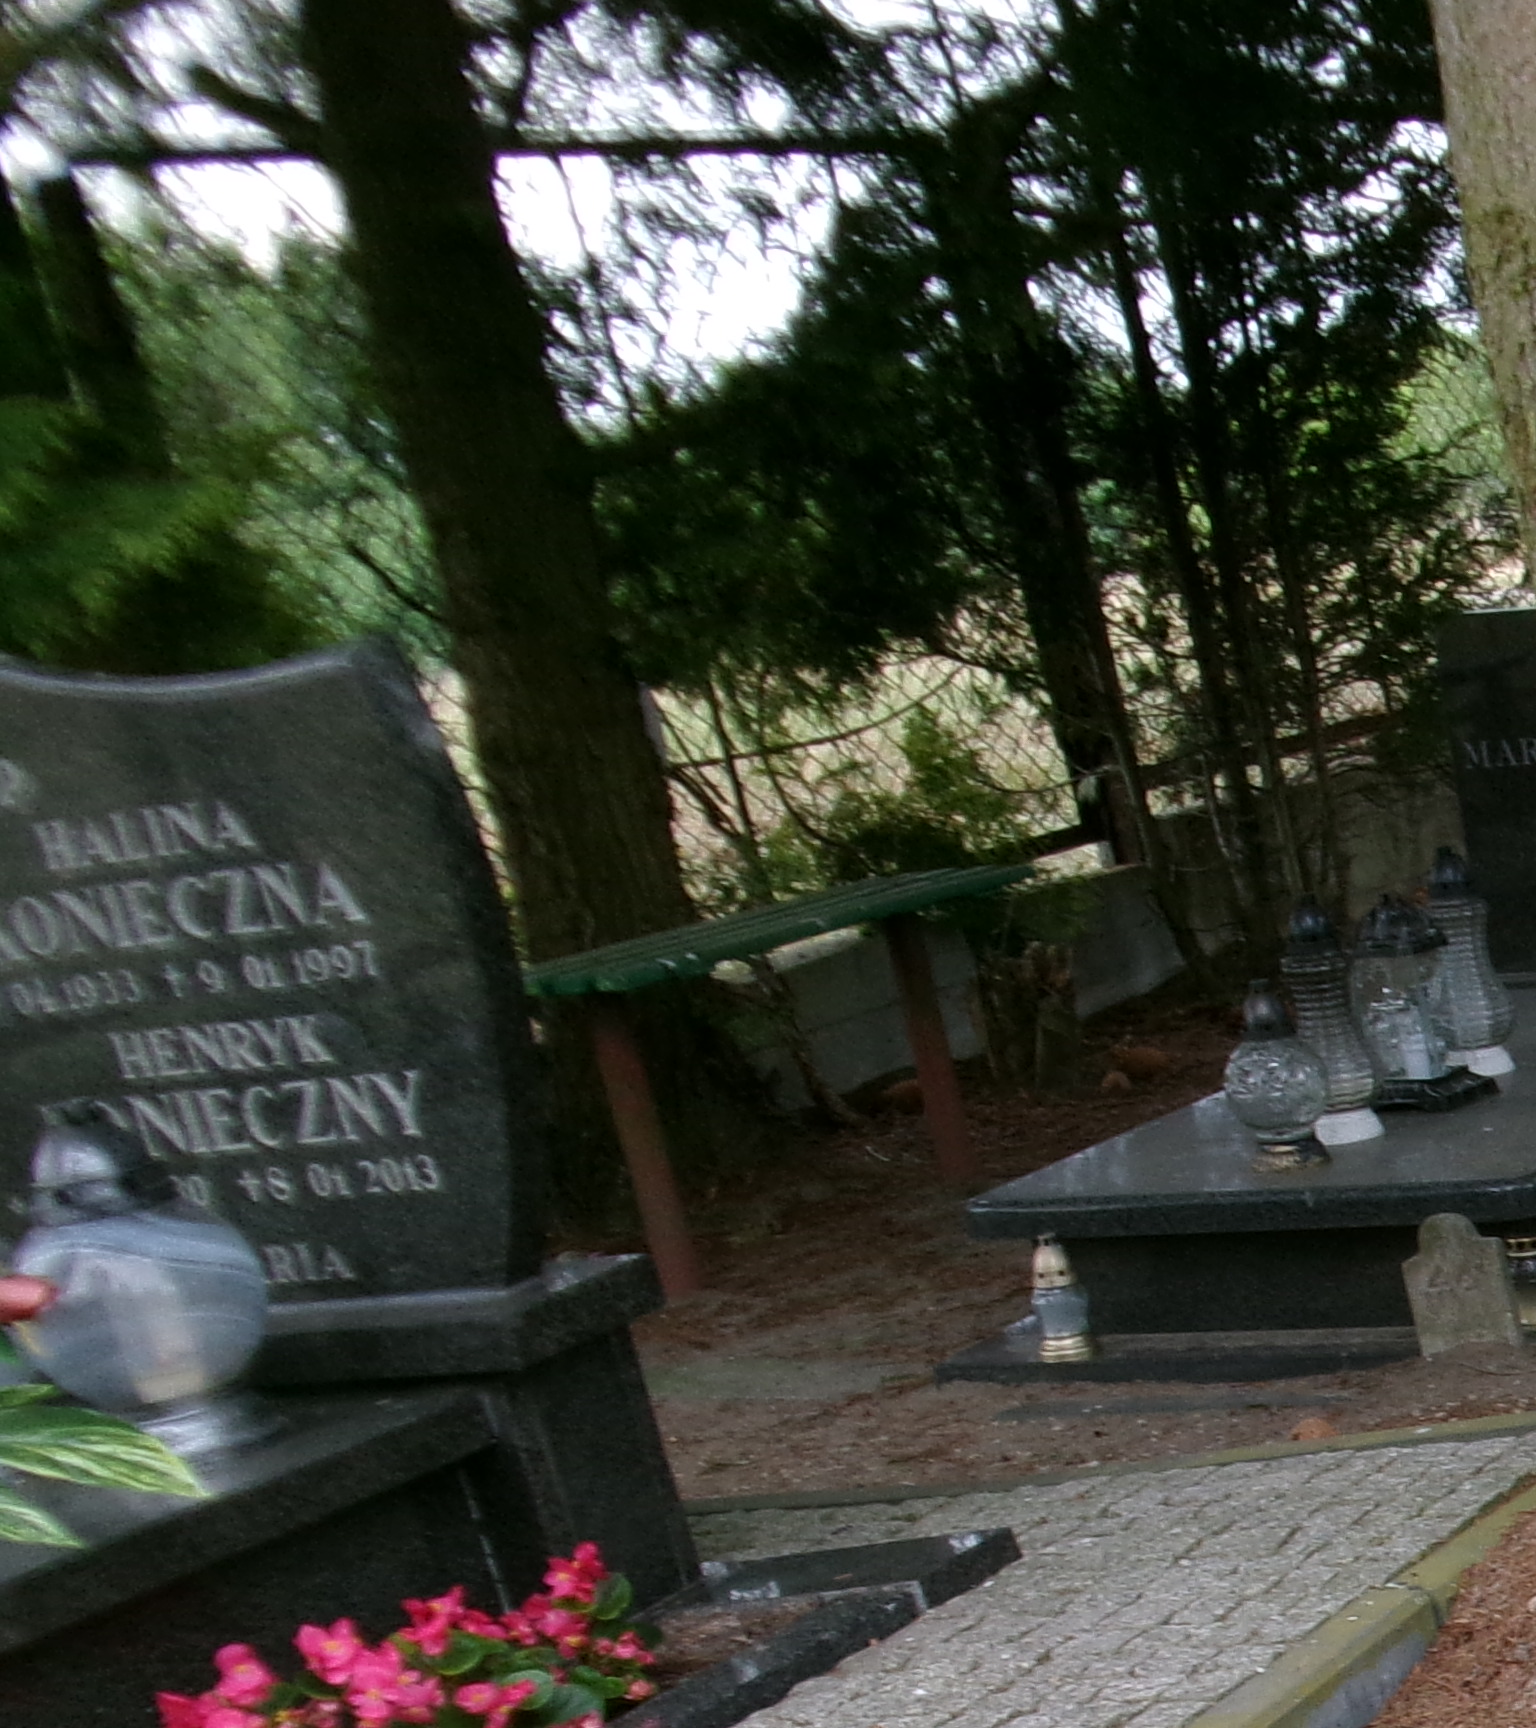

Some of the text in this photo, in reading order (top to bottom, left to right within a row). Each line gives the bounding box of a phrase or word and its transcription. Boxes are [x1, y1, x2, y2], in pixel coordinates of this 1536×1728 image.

[32, 800, 256, 869] HALINA
[0, 864, 372, 962] ONIECZNA
[109, 1015, 334, 1080] HENRYK
[41, 1070, 423, 1161] NIECZNY
[261, 1245, 356, 1283] RIA
